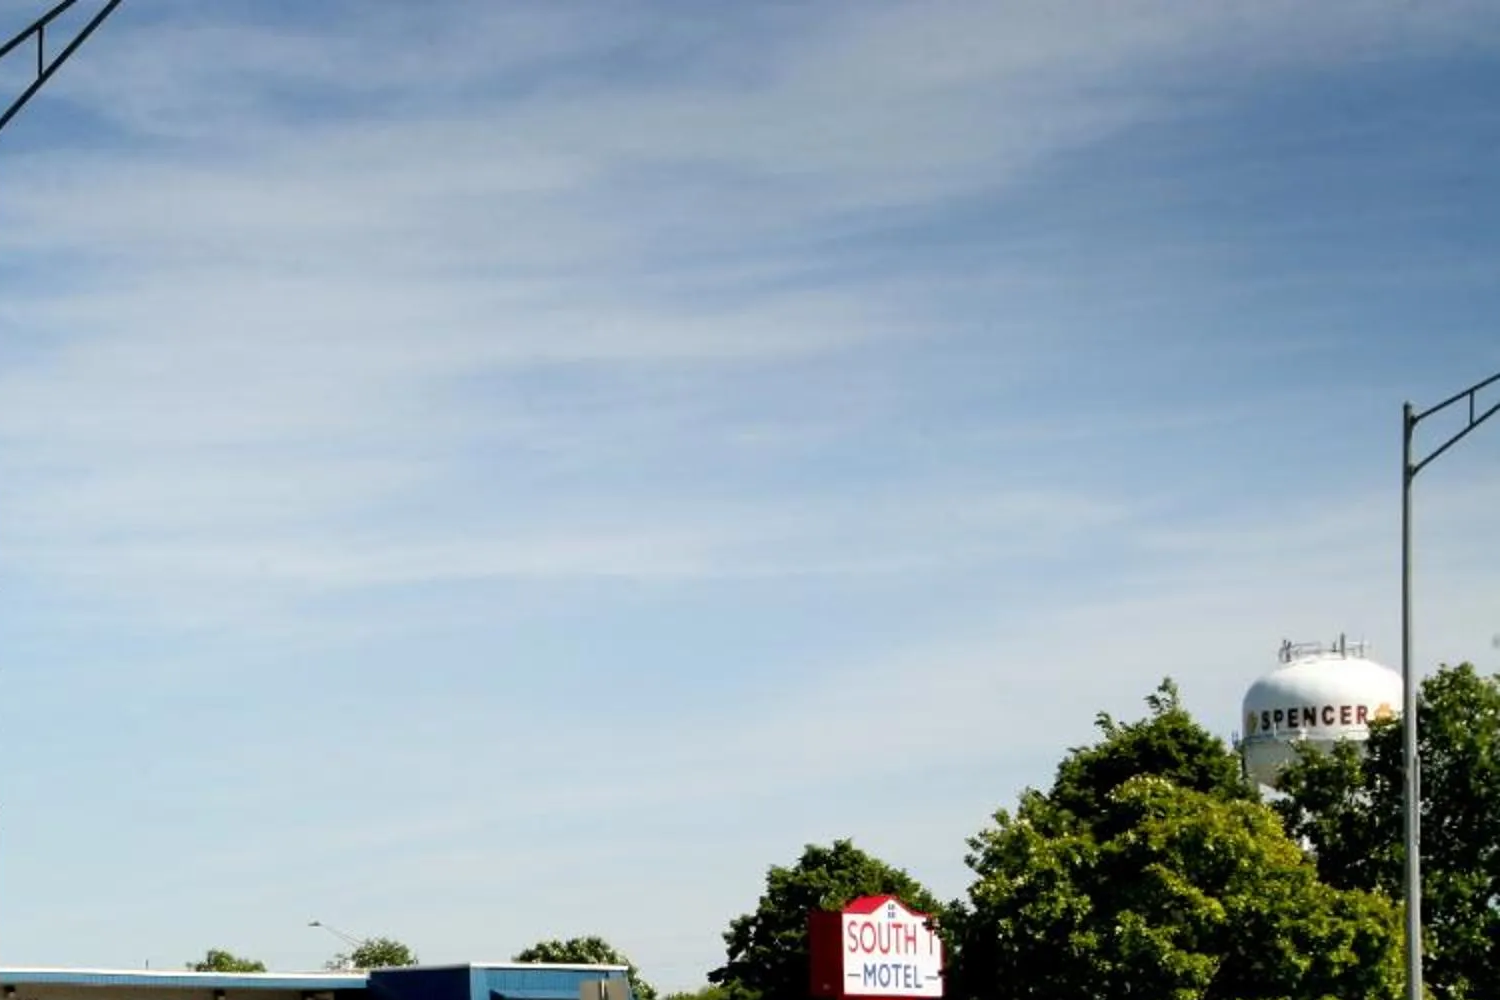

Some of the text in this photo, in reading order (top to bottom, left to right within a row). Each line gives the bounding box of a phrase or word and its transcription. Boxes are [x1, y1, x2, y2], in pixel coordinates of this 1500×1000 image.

[1261, 705, 1369, 731] SPENCER
[847, 921, 917, 955] SOUTH
[864, 963, 922, 989] MOTEL
